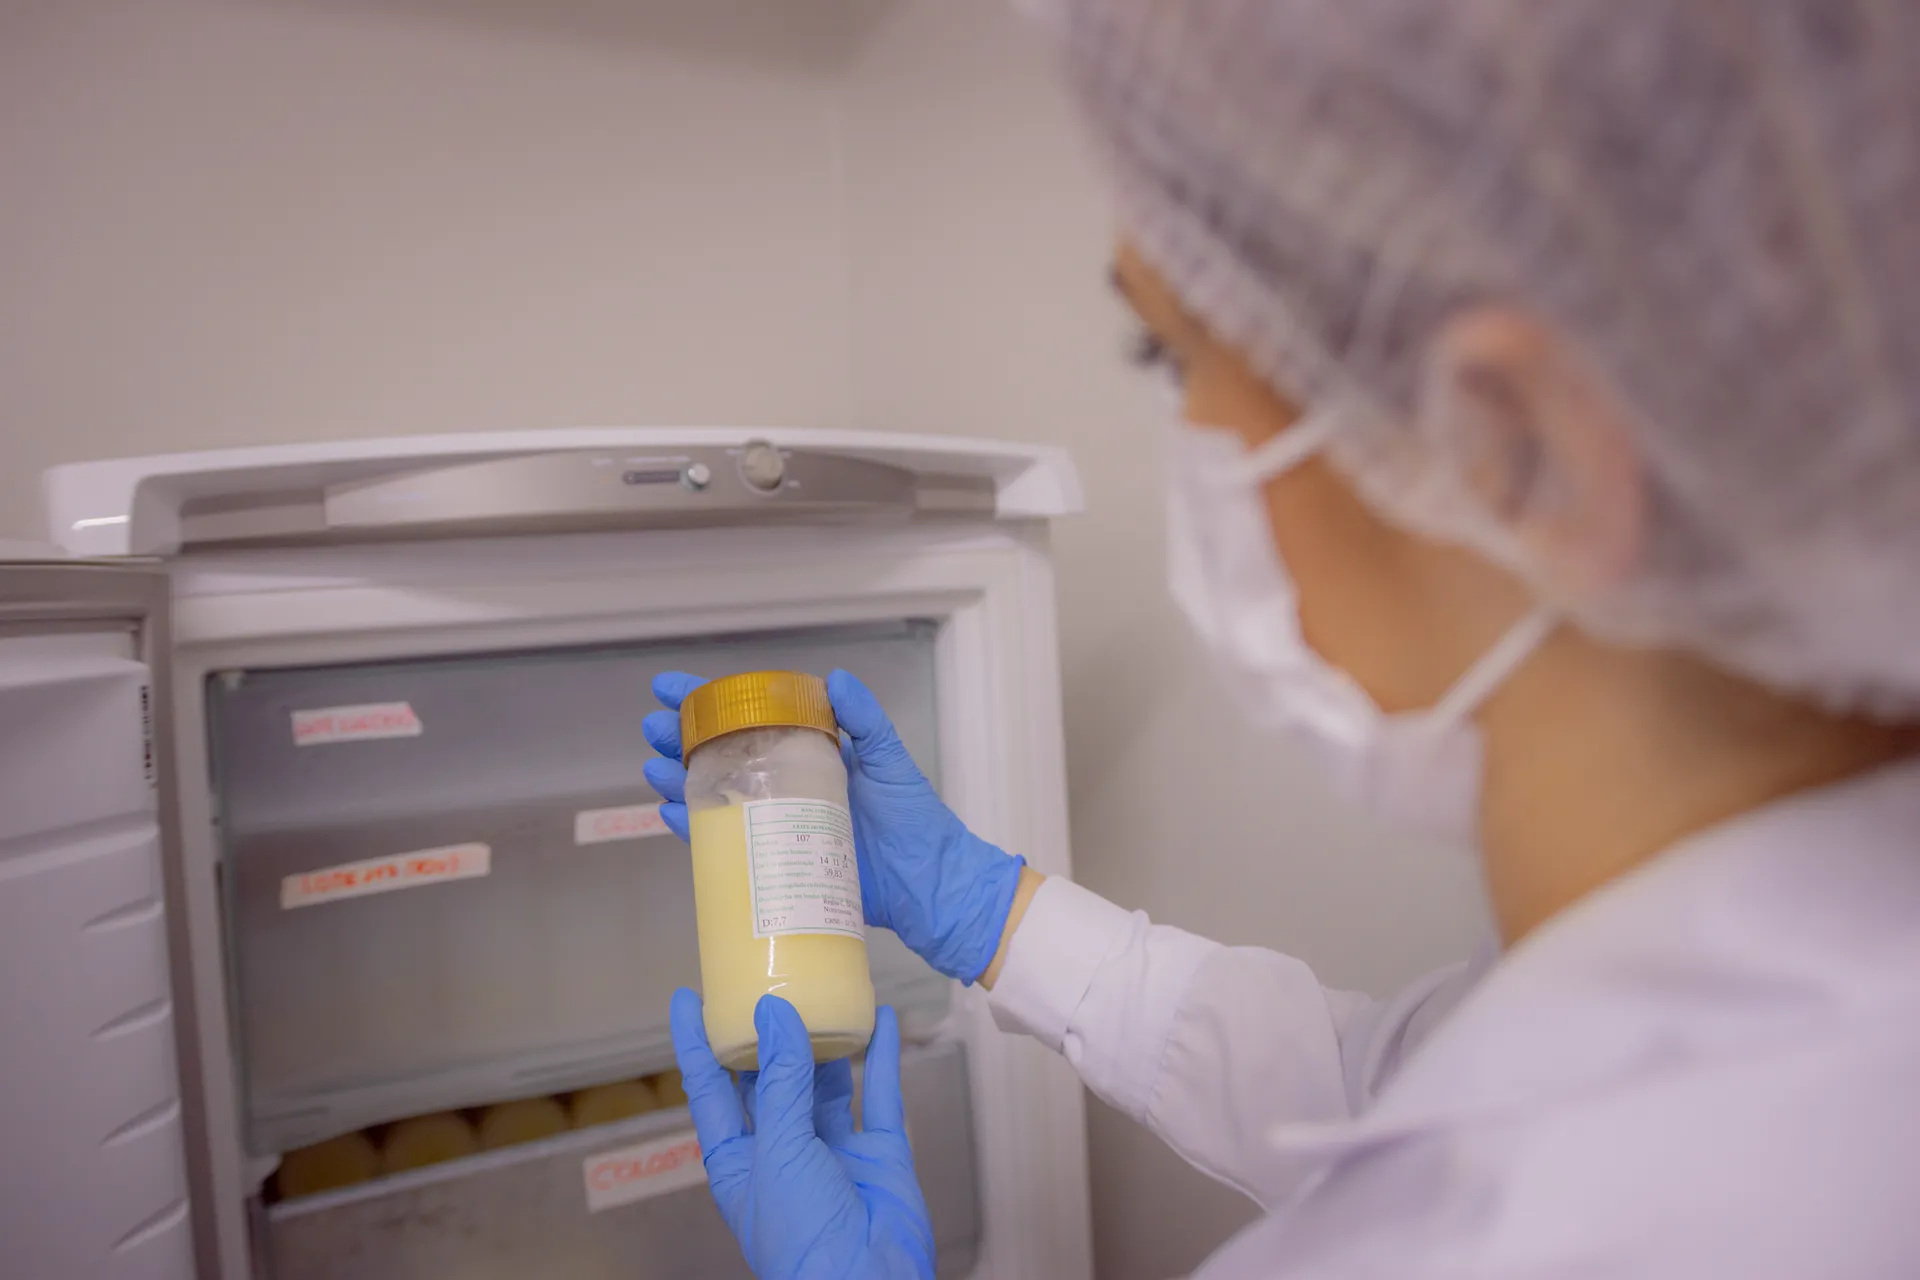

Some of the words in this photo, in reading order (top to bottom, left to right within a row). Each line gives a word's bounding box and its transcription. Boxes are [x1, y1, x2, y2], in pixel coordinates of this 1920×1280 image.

[796, 834, 811, 842] 107
[819, 856, 829, 864] 14
[762, 916, 787, 928] D:7,7
